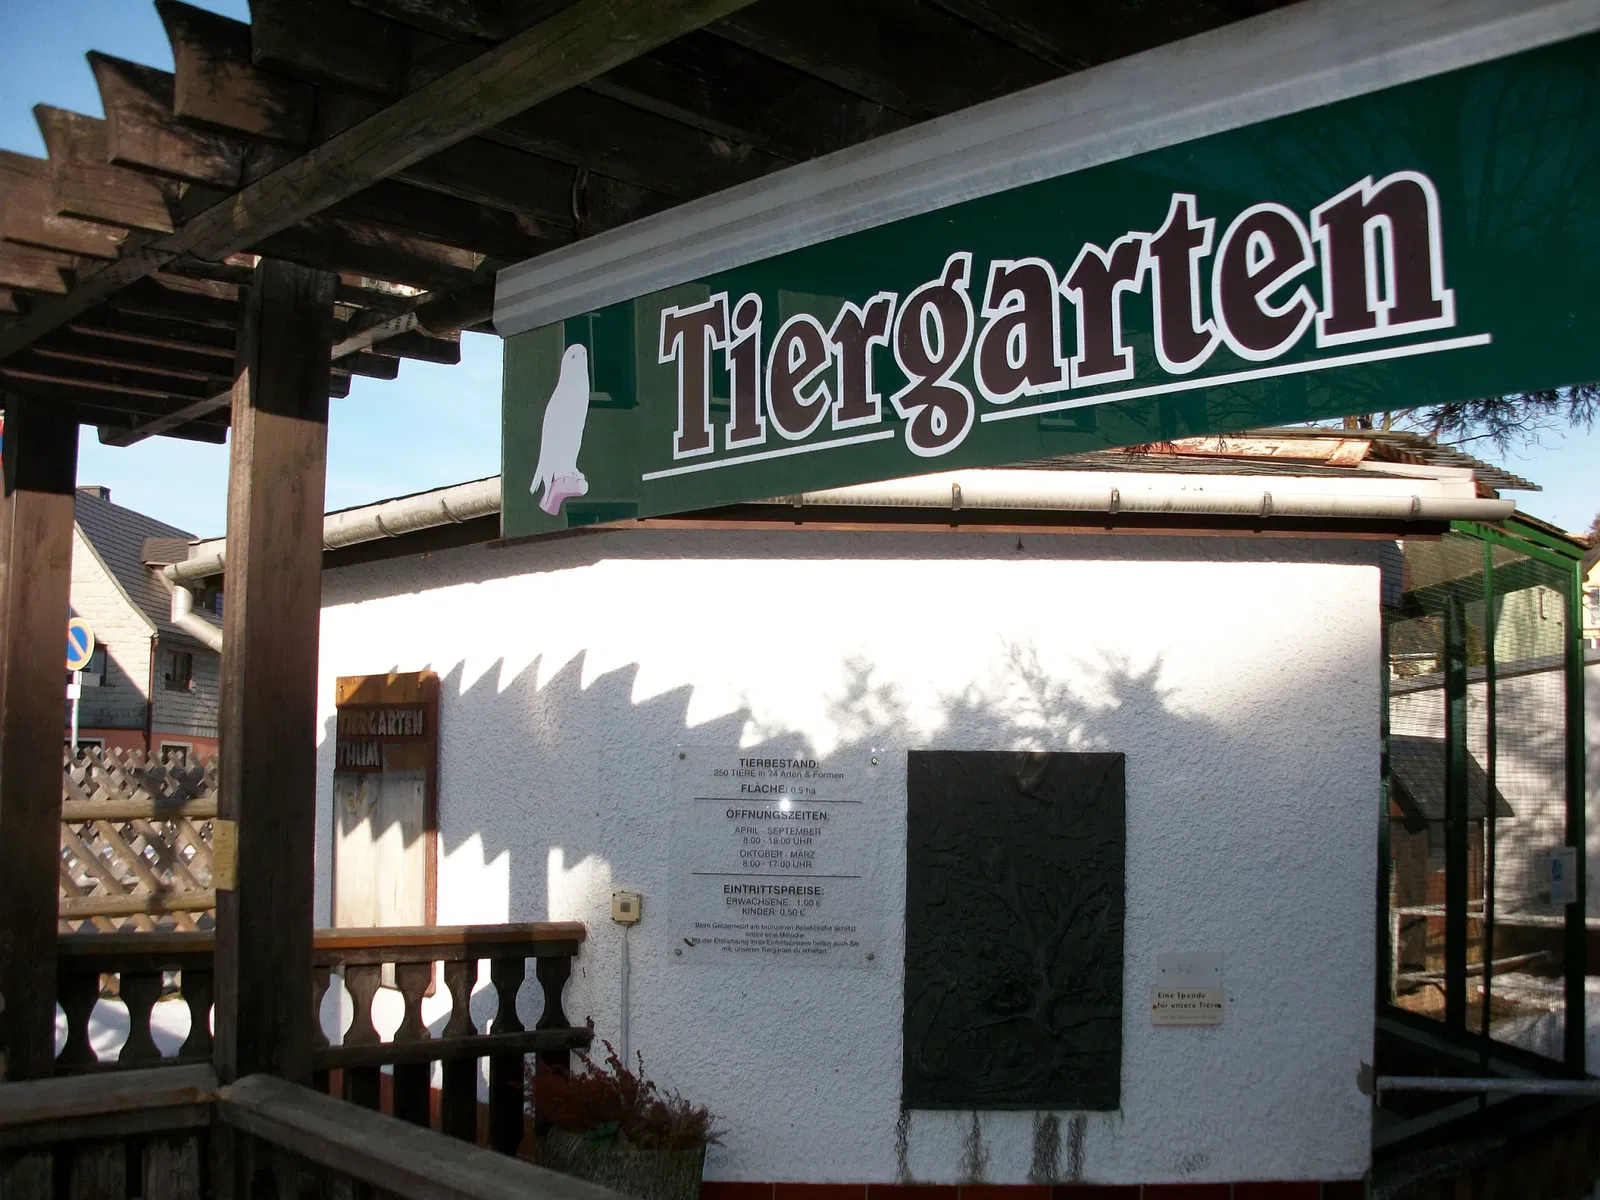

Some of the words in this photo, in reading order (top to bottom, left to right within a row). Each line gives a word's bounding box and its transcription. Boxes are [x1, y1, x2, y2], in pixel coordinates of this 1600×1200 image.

[657, 169, 1456, 458] Tiergarten
[738, 757, 820, 770] TIERBESTAND:
[713, 768, 729, 777] 250
[730, 768, 756, 778] TIERE
[758, 768, 766, 778] in
[768, 769, 778, 778] 74
[780, 770, 801, 779] Arten
[812, 770, 845, 780] Formen
[740, 781, 788, 795] FLÄCHE:
[805, 786, 817, 795] ha
[725, 808, 831, 821] ÖFFNUNGSZEITEN:
[734, 826, 760, 835] APRIL
[767, 826, 822, 836] SEPTEMBER
[793, 837, 813, 846] UHR
[739, 849, 783, 858] OKTOBER
[792, 860, 812, 869] UHR
[723, 884, 825, 896] EINTRITTSPREISE:
[725, 896, 792, 907] ERWACHSENE:
[797, 899, 813, 908] 1,00
[741, 907, 777, 916] KINDER:
[799, 908, 806, 917] €
[1177, 991, 1207, 1000] Spende
